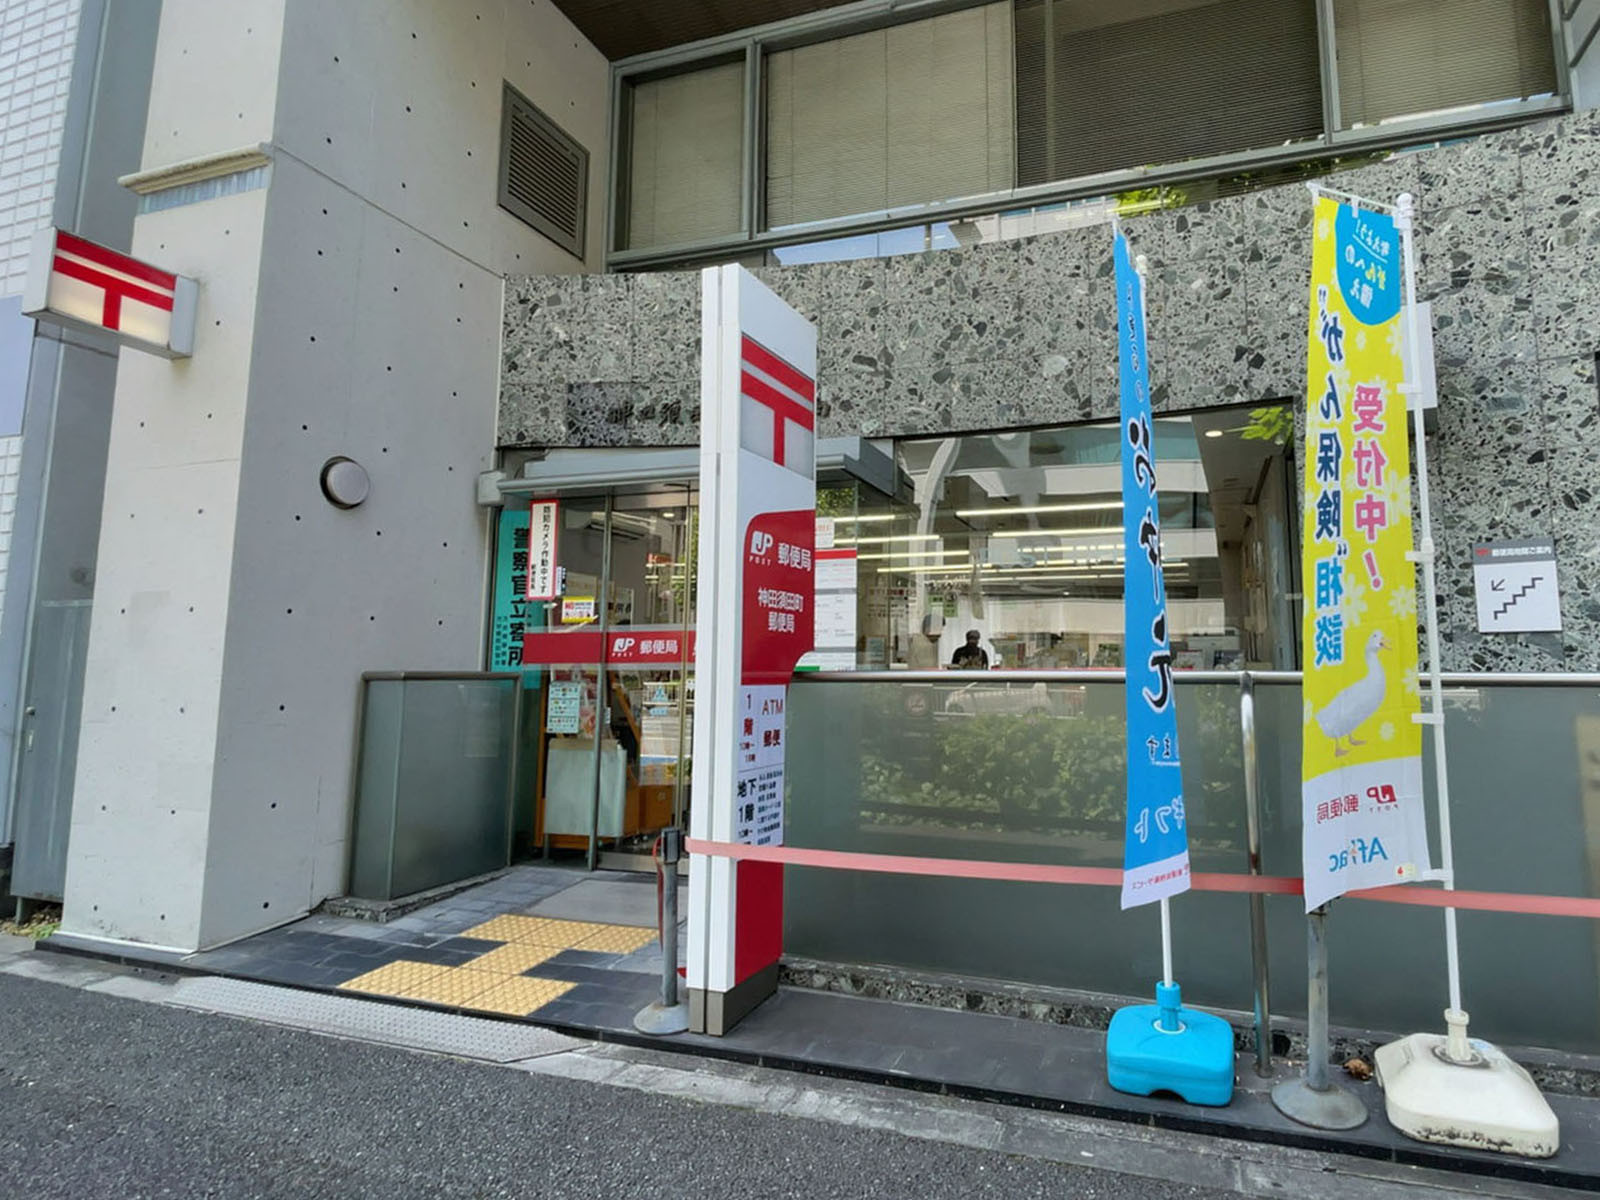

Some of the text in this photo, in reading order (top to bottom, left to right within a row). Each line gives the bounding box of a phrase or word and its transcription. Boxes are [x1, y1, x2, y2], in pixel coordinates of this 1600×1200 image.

[777, 542, 812, 572] 郵便局
[757, 587, 804, 613] 神田須田町
[768, 612, 796, 634] 郵便局
[640, 639, 679, 655] 郵便局
[762, 699, 783, 715] ATM
[737, 778, 757, 798] 地下
